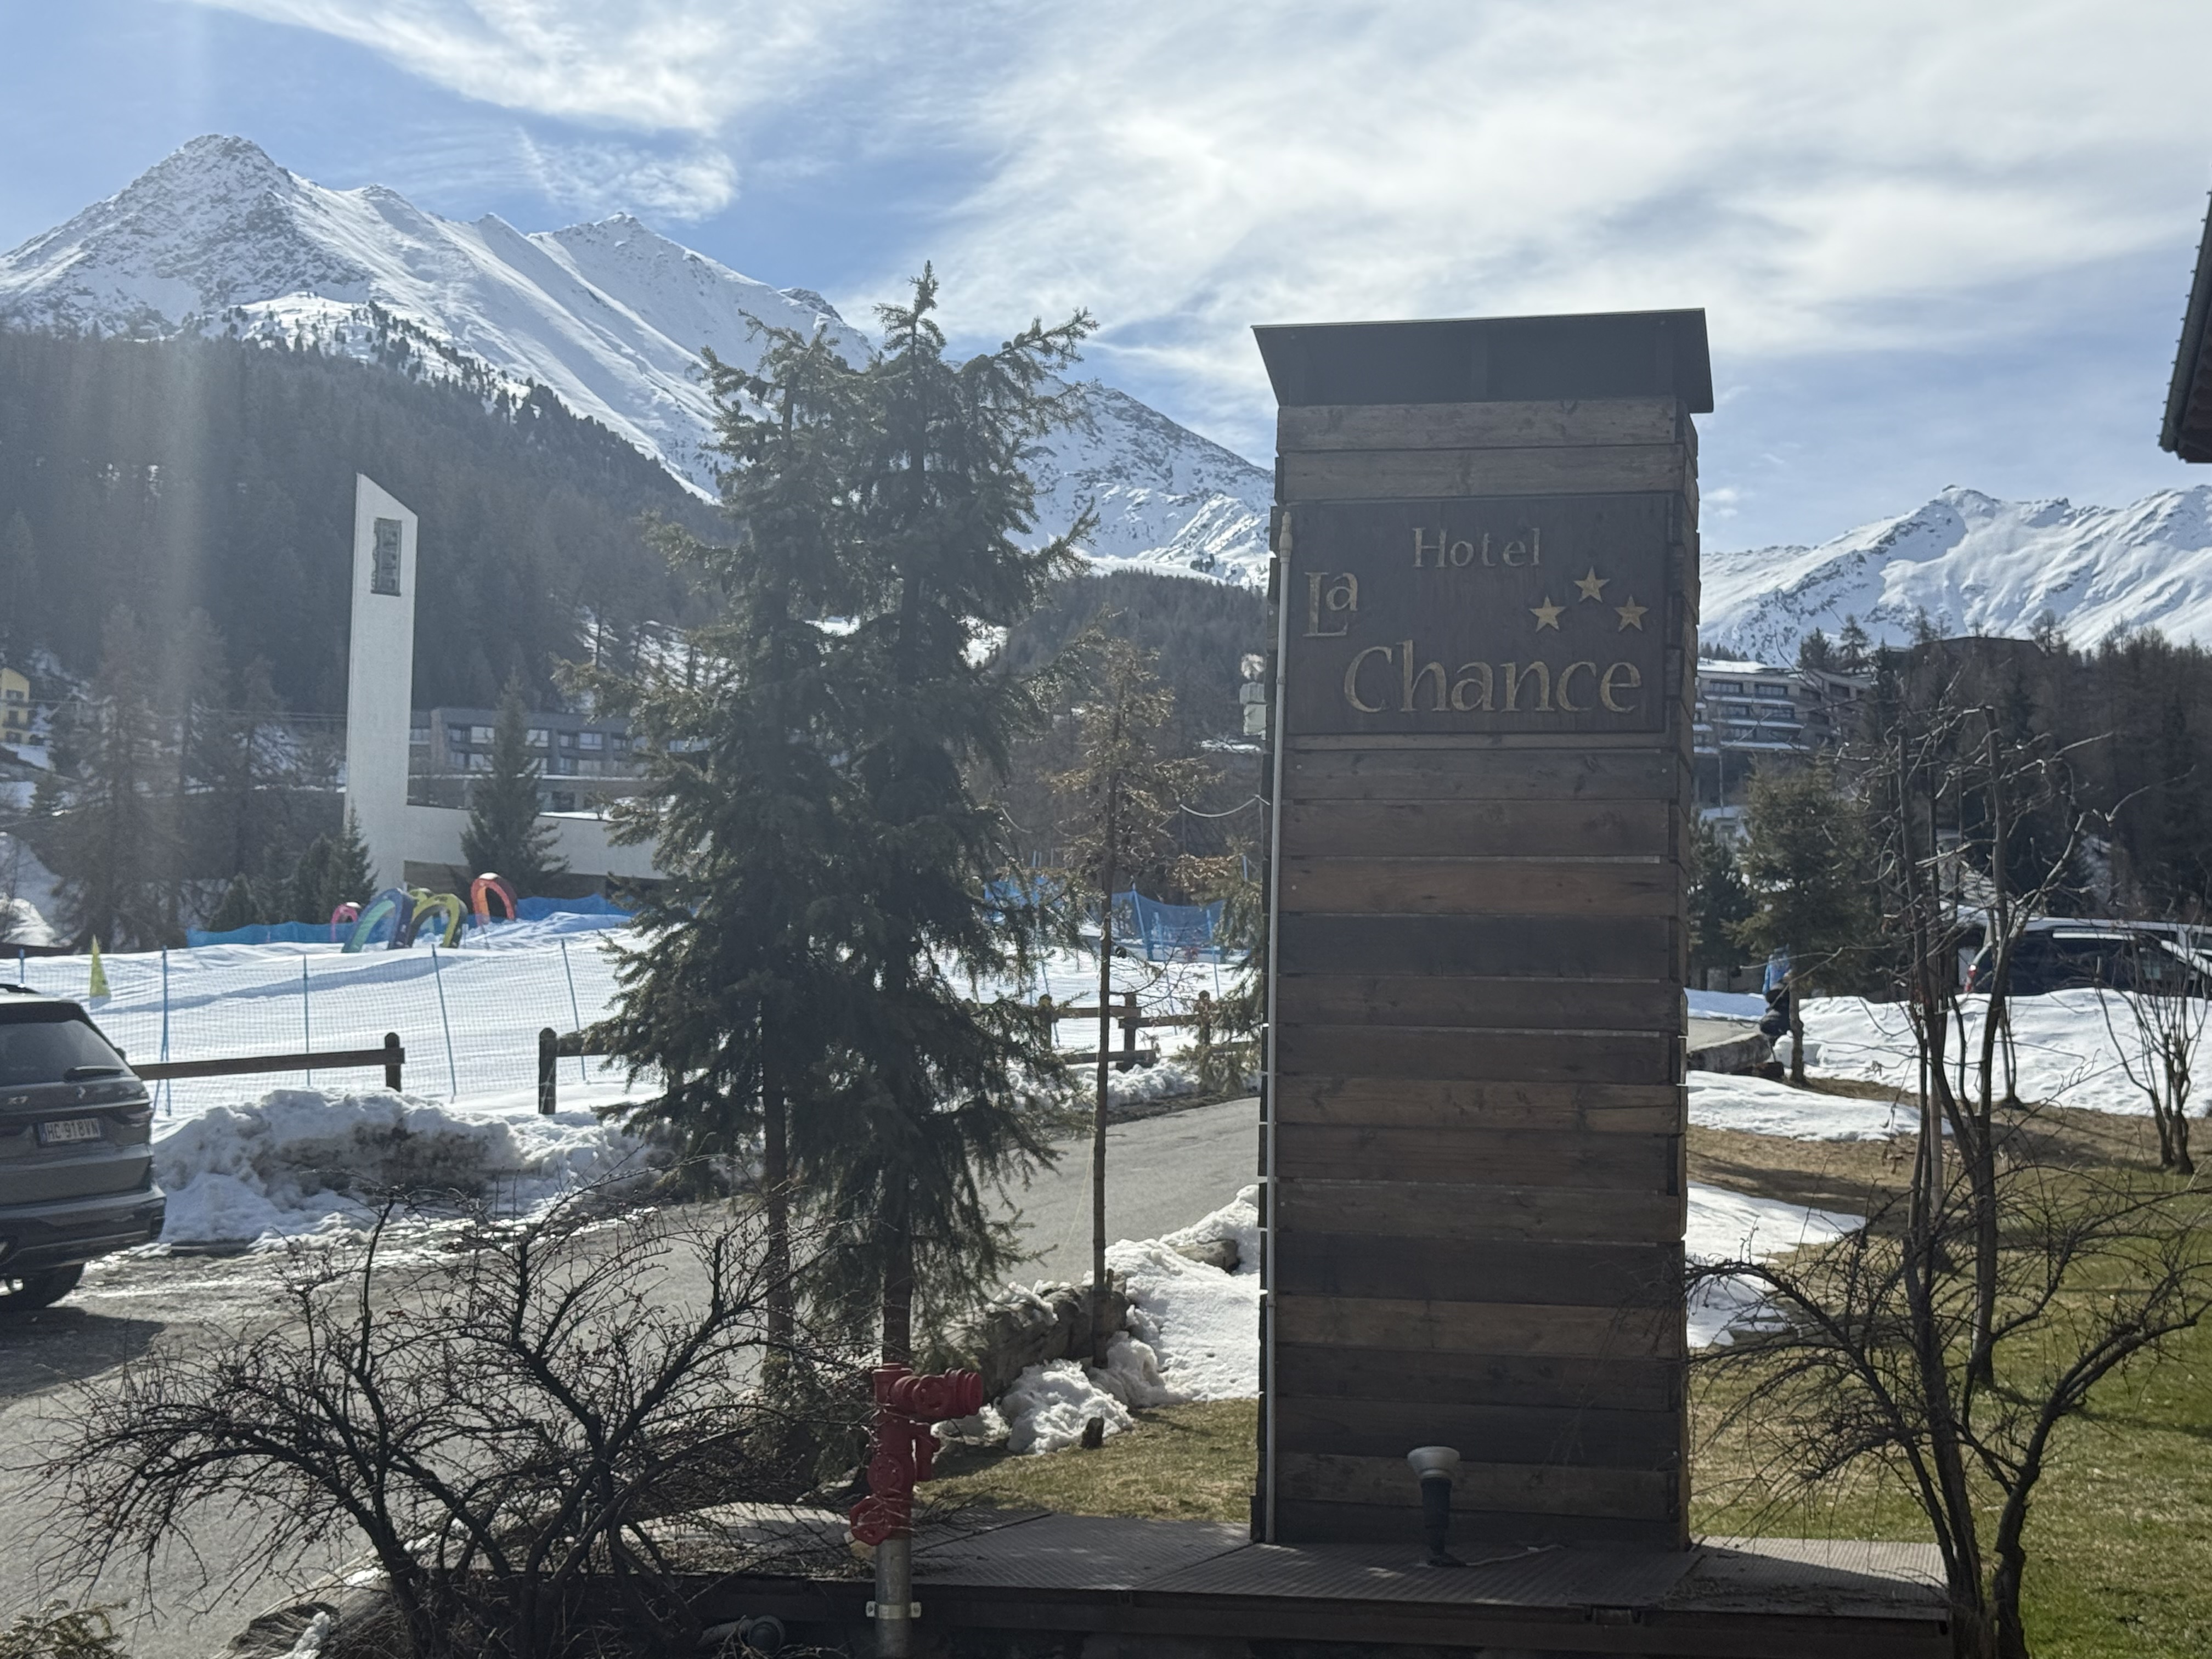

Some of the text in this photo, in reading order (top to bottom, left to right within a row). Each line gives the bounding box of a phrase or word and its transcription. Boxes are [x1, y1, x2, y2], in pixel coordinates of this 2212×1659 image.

[1413, 528, 1541, 568] Hotel
[1302, 571, 1358, 637] La
[1344, 639, 1643, 713] Chance
